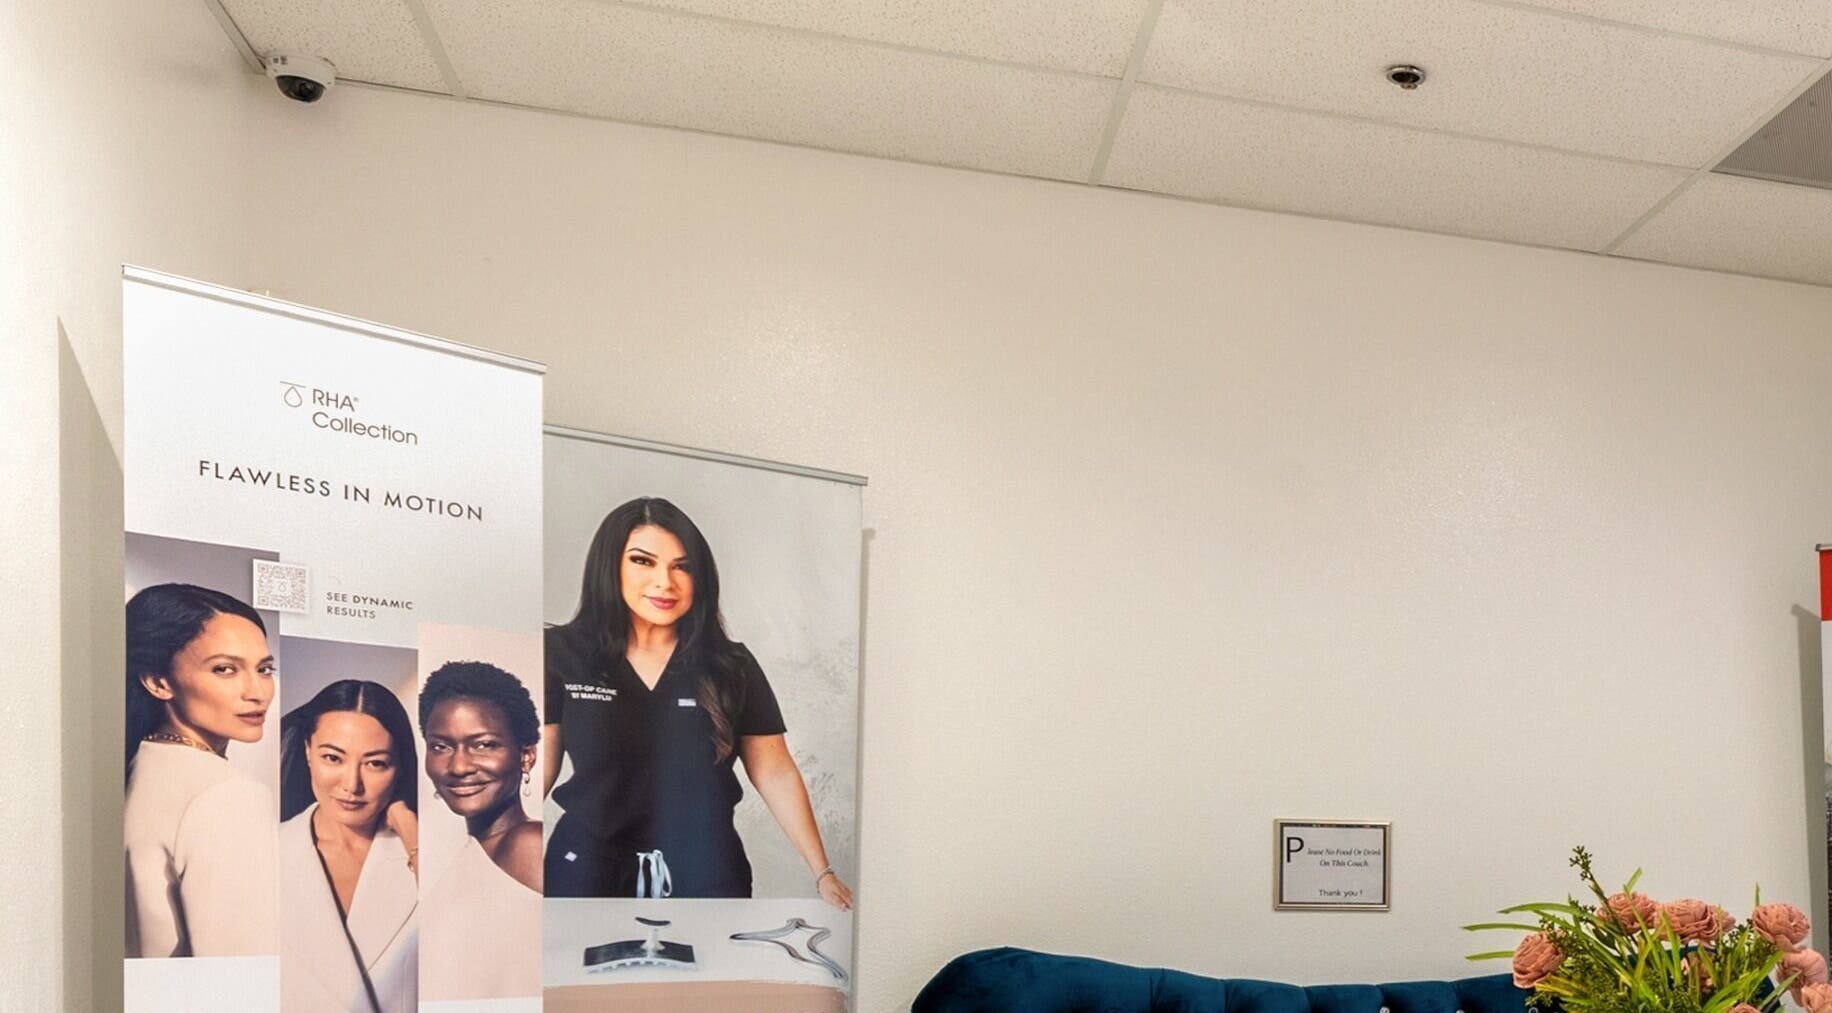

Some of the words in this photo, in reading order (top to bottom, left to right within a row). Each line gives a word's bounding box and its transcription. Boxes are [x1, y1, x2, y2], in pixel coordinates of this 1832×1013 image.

[312, 411, 418, 445] Collection
[199, 460, 331, 497] FLAWLESS
[344, 484, 370, 503] IN
[384, 490, 484, 521] MOTION
[327, 591, 347, 602] SEE
[352, 595, 413, 610] DYNAMIC
[327, 606, 376, 619] RESULTS
[1332, 859, 1346, 867] This
[1347, 859, 1369, 867] Couch
[1319, 888, 1341, 897] Thank
[1343, 889, 1358, 898] you
